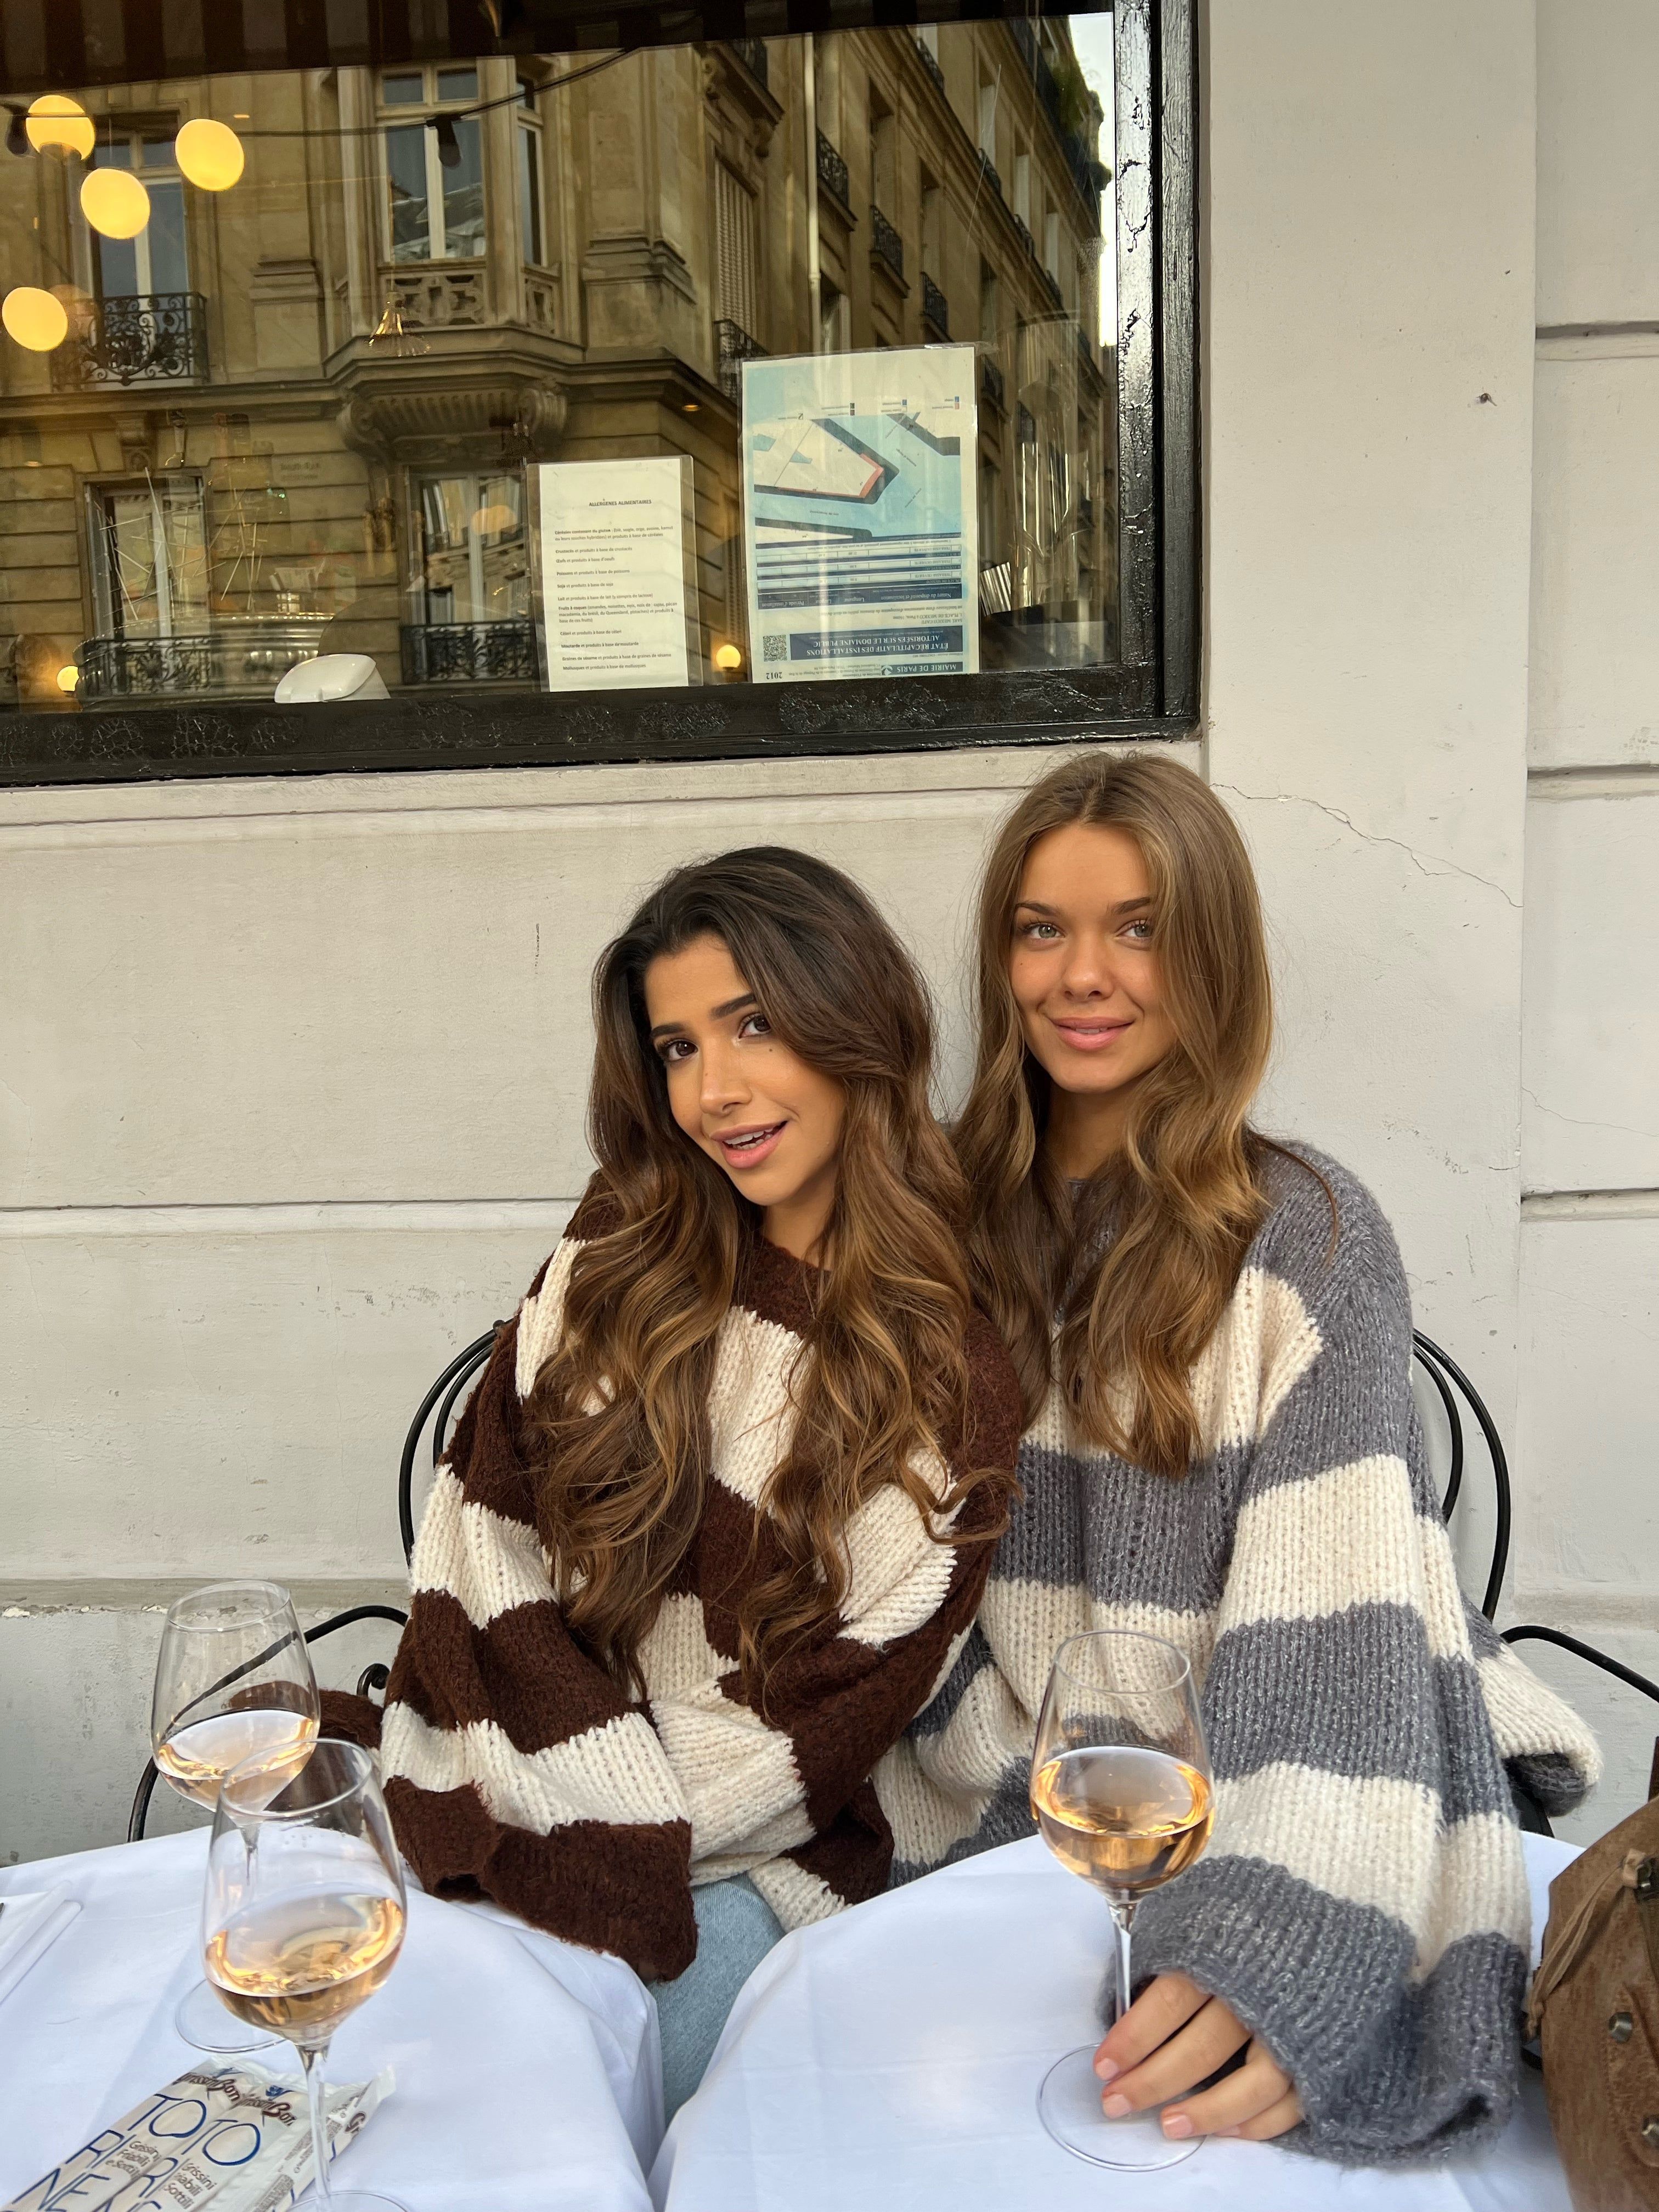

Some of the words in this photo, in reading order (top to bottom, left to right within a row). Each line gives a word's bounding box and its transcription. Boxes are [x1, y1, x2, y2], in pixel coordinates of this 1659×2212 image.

[838, 637, 871, 646] DOMAINE
[898, 634, 939, 644] AUTORISÉES
[876, 643, 929, 653] RÉCAPITULATIF
[929, 642, 948, 650] ÉTAT
[806, 647, 860, 656] INSTALLATIONS
[766, 671, 782, 679] 2012
[127, 2094, 207, 2138] TO
[182, 2119, 261, 2166] TO
[129, 2141, 162, 2162] Grissini
